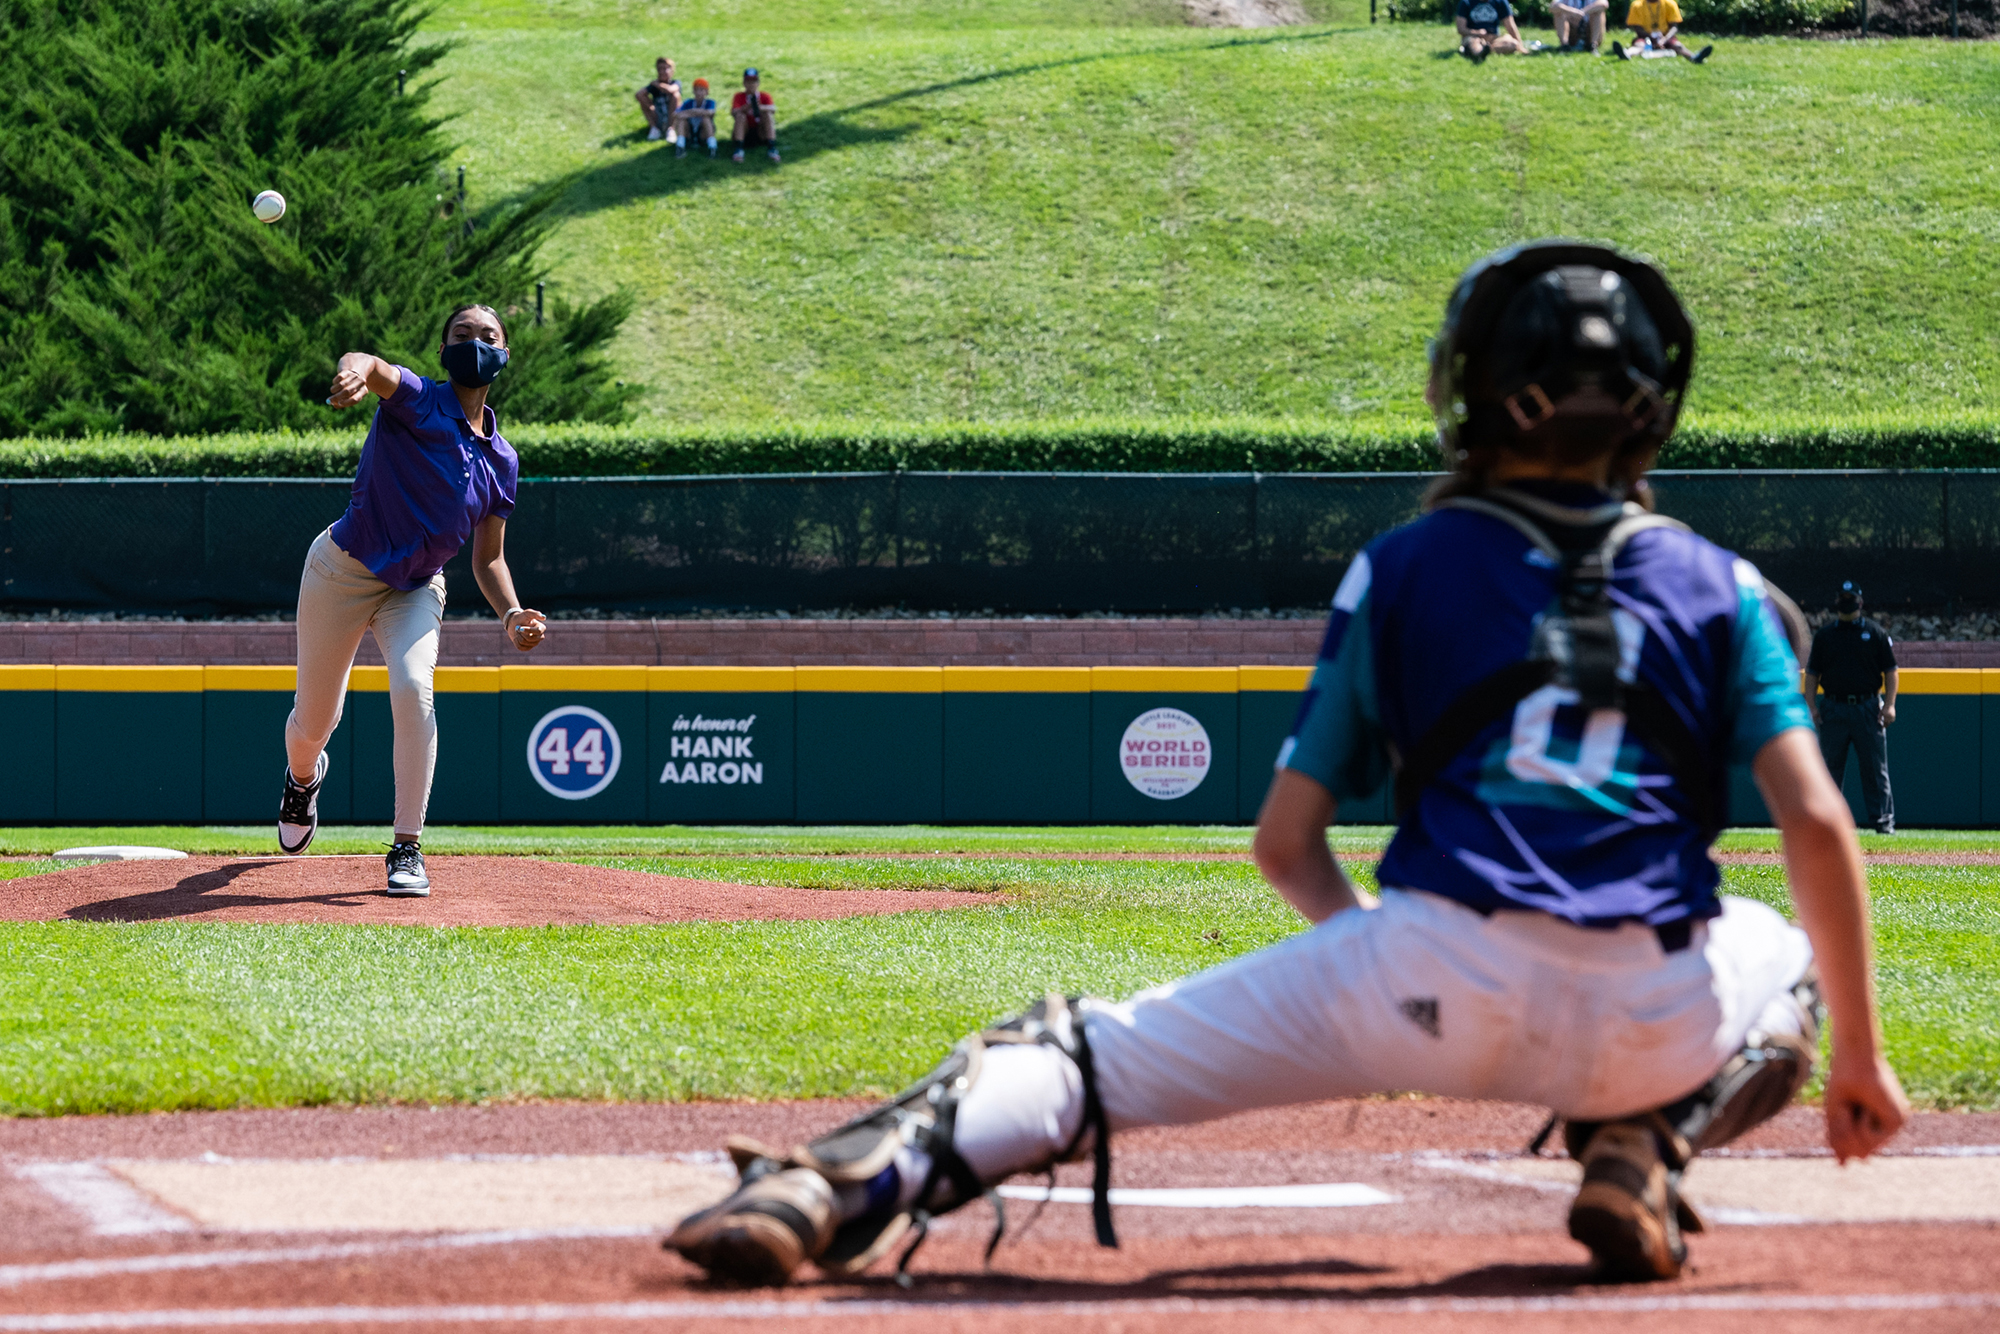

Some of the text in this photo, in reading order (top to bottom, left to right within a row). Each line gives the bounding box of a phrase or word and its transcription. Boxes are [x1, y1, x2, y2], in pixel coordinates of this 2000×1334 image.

[672, 713, 757, 734] in honor of
[537, 727, 606, 775] 44
[670, 735, 754, 758] HANK
[1126, 740, 1206, 752] WORLD
[1125, 755, 1207, 767] SERIES
[659, 761, 763, 785] AARON
